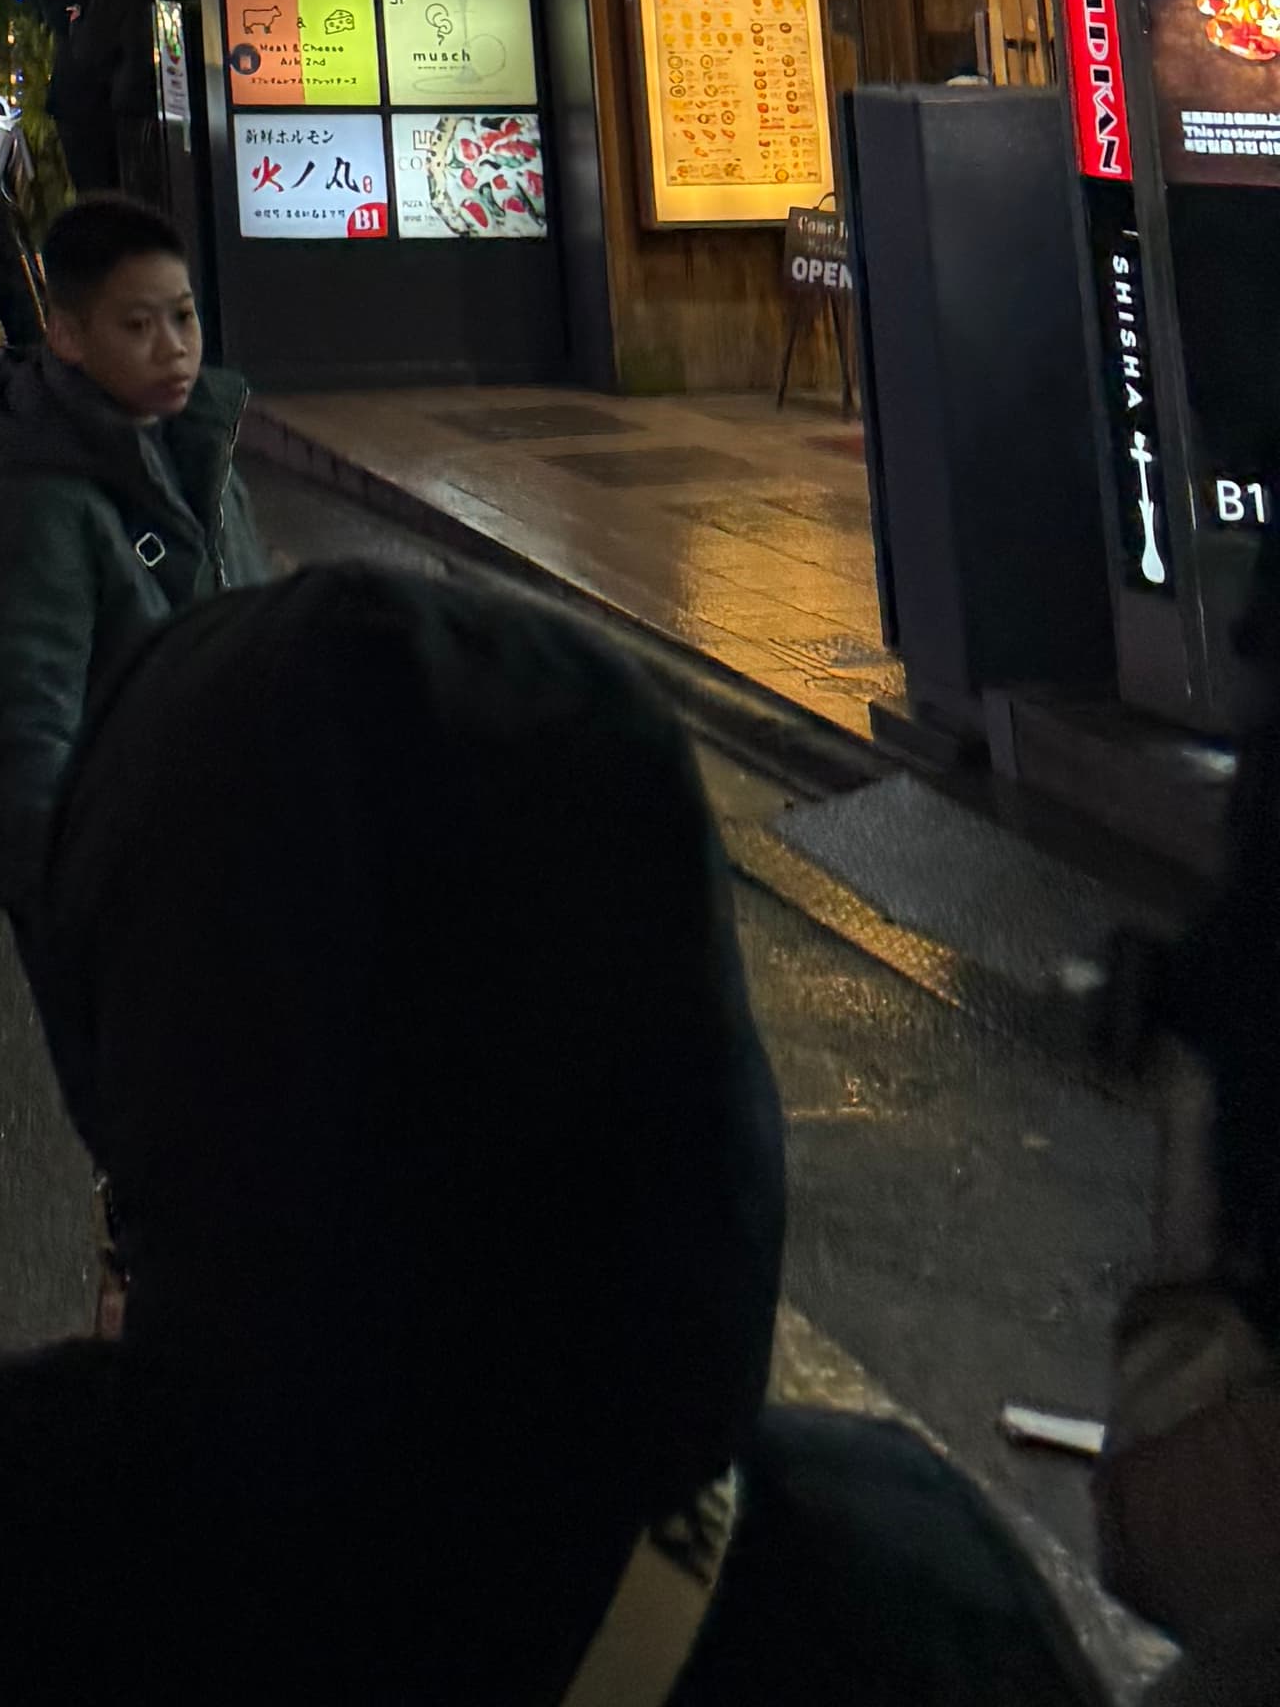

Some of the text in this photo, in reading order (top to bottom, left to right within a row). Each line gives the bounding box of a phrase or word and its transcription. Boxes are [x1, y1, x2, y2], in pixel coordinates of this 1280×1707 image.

[413, 49, 471, 62] musch
[1091, 69, 1123, 174] KAN
[251, 156, 361, 193] 火ノ丸
[354, 209, 380, 230] B1
[791, 256, 853, 289] OPEN
[1112, 255, 1144, 409] SHISHA
[1216, 480, 1265, 523] B1
